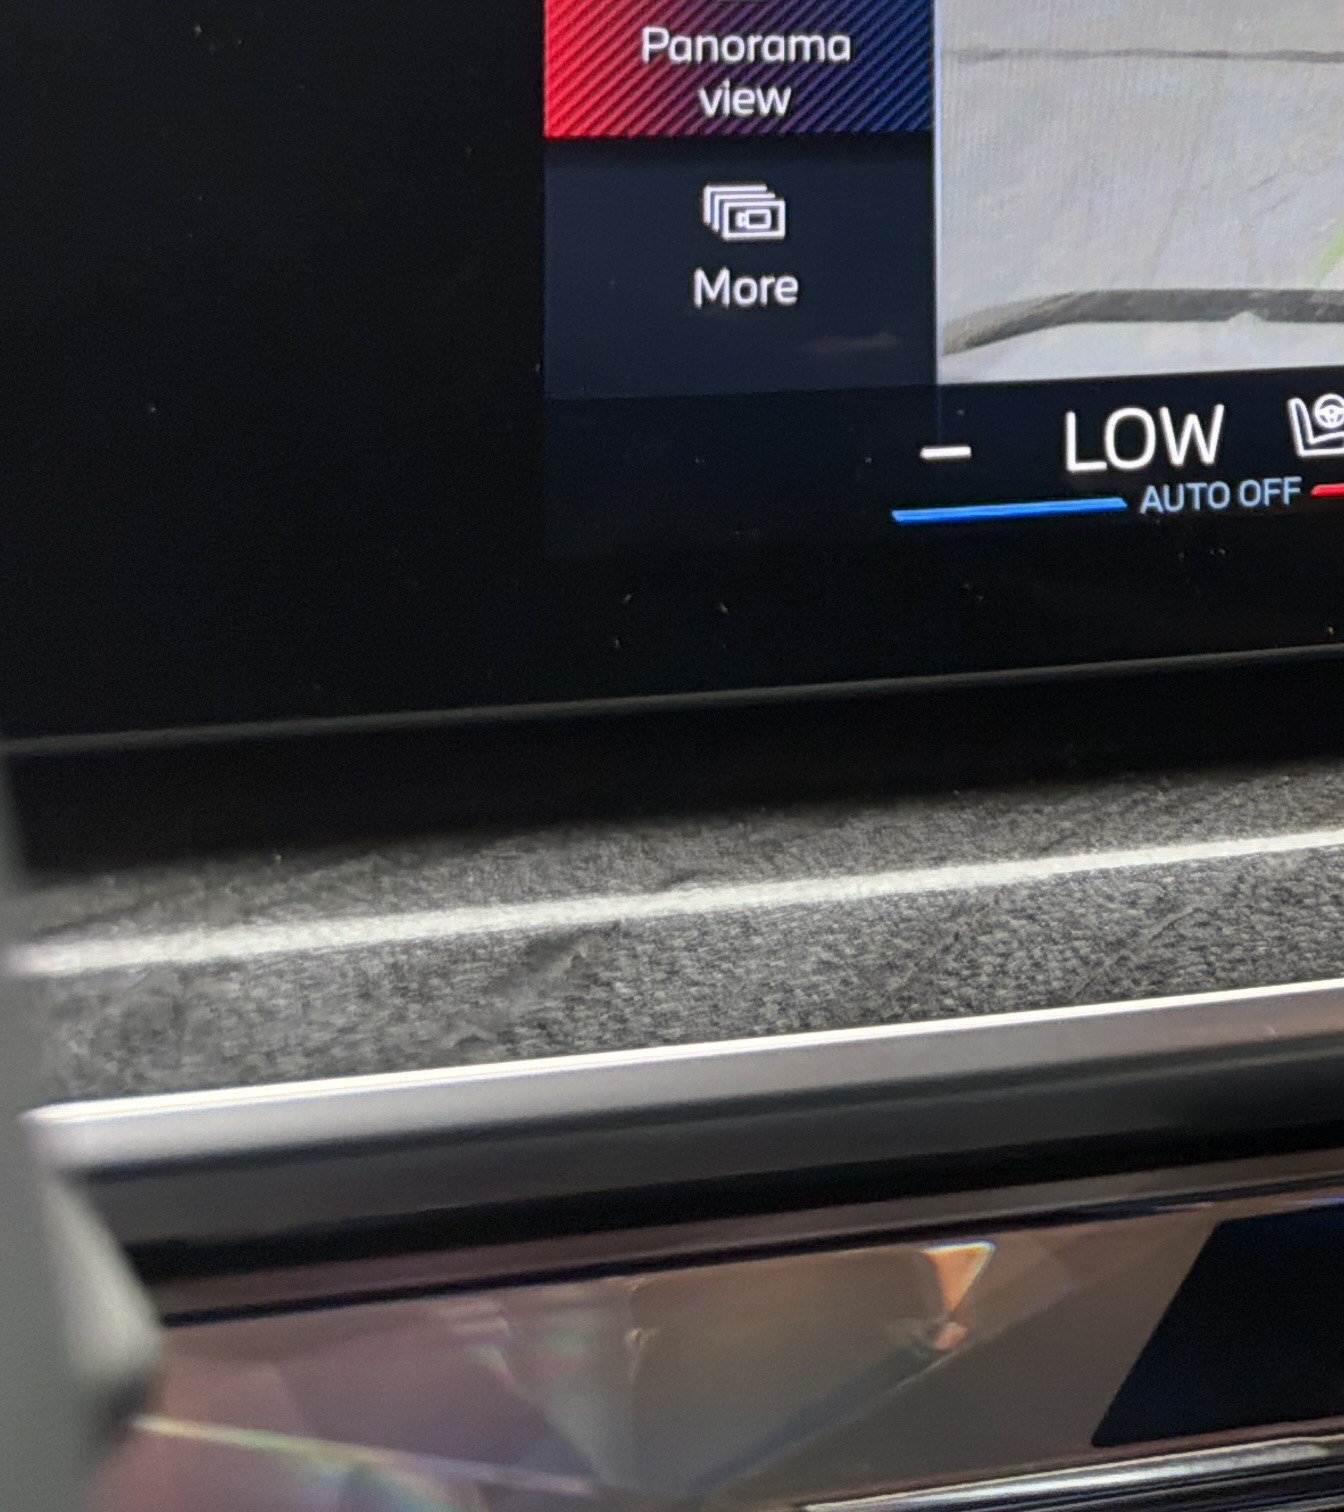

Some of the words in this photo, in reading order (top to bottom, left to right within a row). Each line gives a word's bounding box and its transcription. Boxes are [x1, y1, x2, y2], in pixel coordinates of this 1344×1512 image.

[641, 27, 851, 64] Panorama
[698, 82, 793, 116] view
[693, 270, 799, 308] More
[1063, 403, 1226, 473] LOW
[1139, 481, 1231, 515] AUTO
[1238, 477, 1302, 507] OFF
